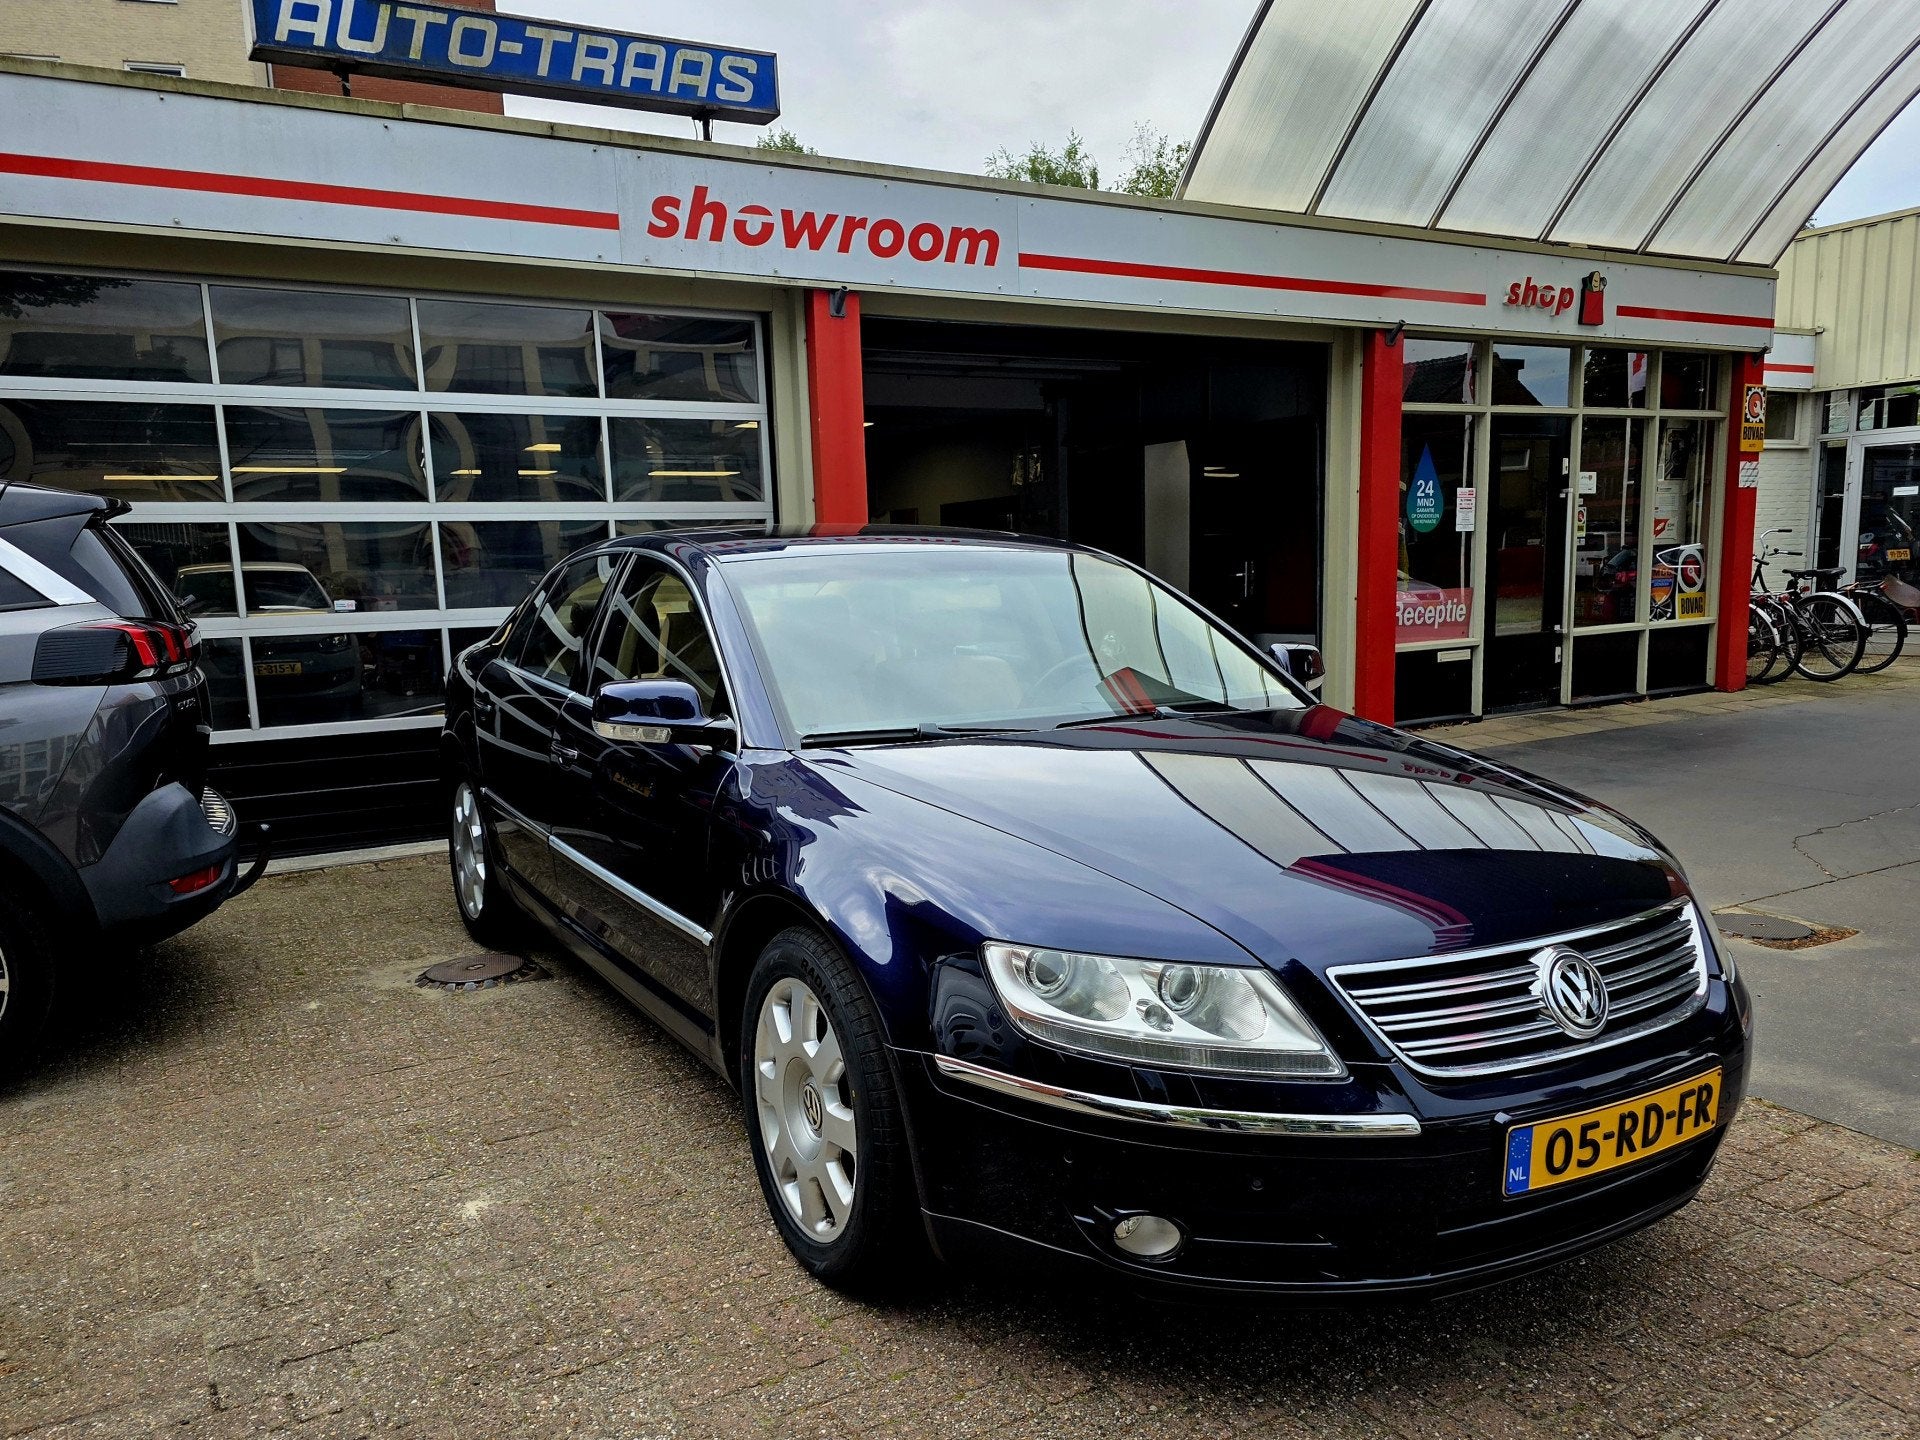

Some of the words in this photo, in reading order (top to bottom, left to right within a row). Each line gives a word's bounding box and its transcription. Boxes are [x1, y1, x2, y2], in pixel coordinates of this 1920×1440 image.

[275, 0, 758, 104] AUTO-TRAAS
[646, 184, 1001, 268] showroom
[1506, 275, 1575, 316] shop
[1742, 425, 1764, 441] BOVAG
[1416, 479, 1435, 497] 24
[1416, 497, 1435, 507] MND
[1395, 598, 1467, 629] Receptie
[1680, 596, 1704, 615] BOVAG
[800, 957, 839, 1019] RADIAL
[1545, 1082, 1714, 1176] 05-RD-FR
[1508, 1167, 1527, 1183] NL
